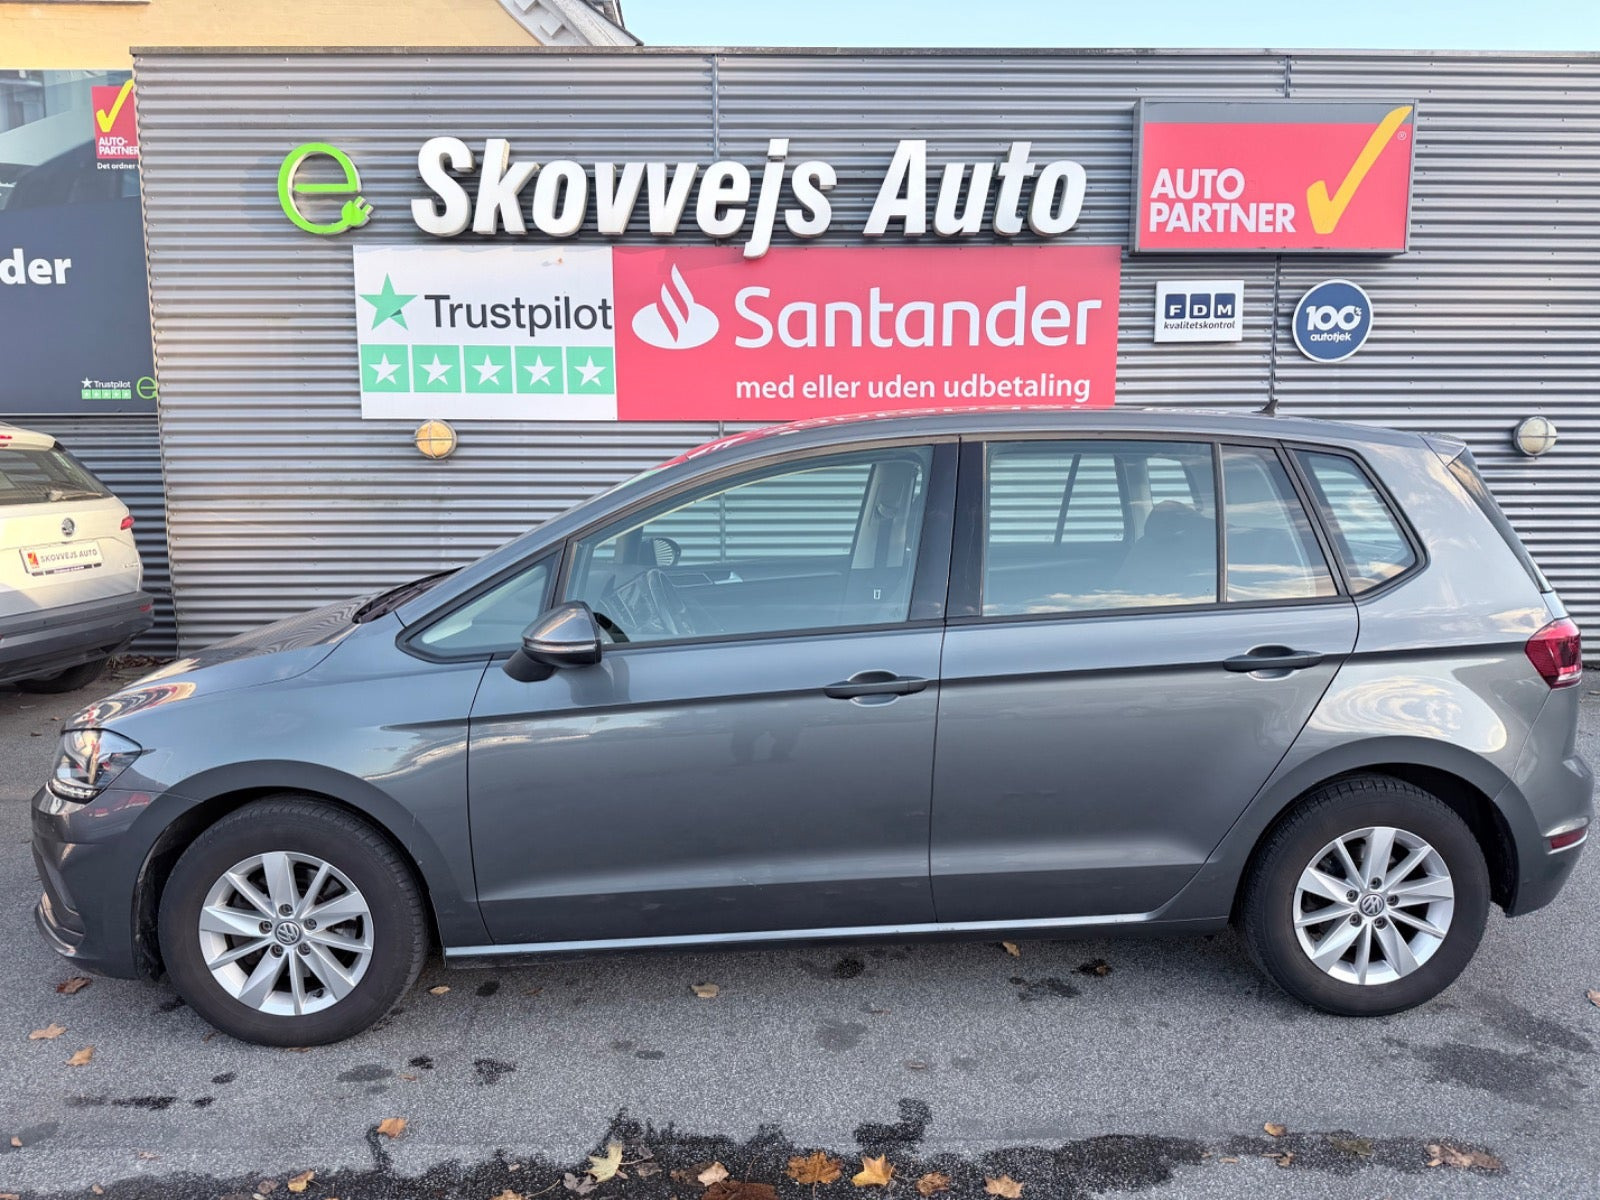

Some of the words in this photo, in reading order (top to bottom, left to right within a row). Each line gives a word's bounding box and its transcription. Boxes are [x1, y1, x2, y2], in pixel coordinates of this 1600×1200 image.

[99, 136, 128, 146] AUTO-
[99, 146, 139, 156] PARTNER
[1150, 168, 1245, 200] AUTO
[411, 136, 837, 259] Skovvejs
[862, 139, 1088, 237] Auto
[1149, 202, 1297, 233] PARTNER
[0, 248, 72, 285] der
[424, 294, 613, 337] Trustpilot
[735, 285, 1102, 348] Santander
[1167, 302, 1234, 318] FDM
[1163, 319, 1236, 330] kvalitetskontrol
[1310, 331, 1352, 343] autotjek
[94, 381, 131, 389] Trustpilot
[736, 375, 795, 399] med
[802, 374, 861, 399] eller
[868, 374, 935, 398] uden
[943, 373, 1091, 402] udbetaling
[40, 551, 78, 562] SKOVVEJS
[79, 549, 98, 558] AUTO
